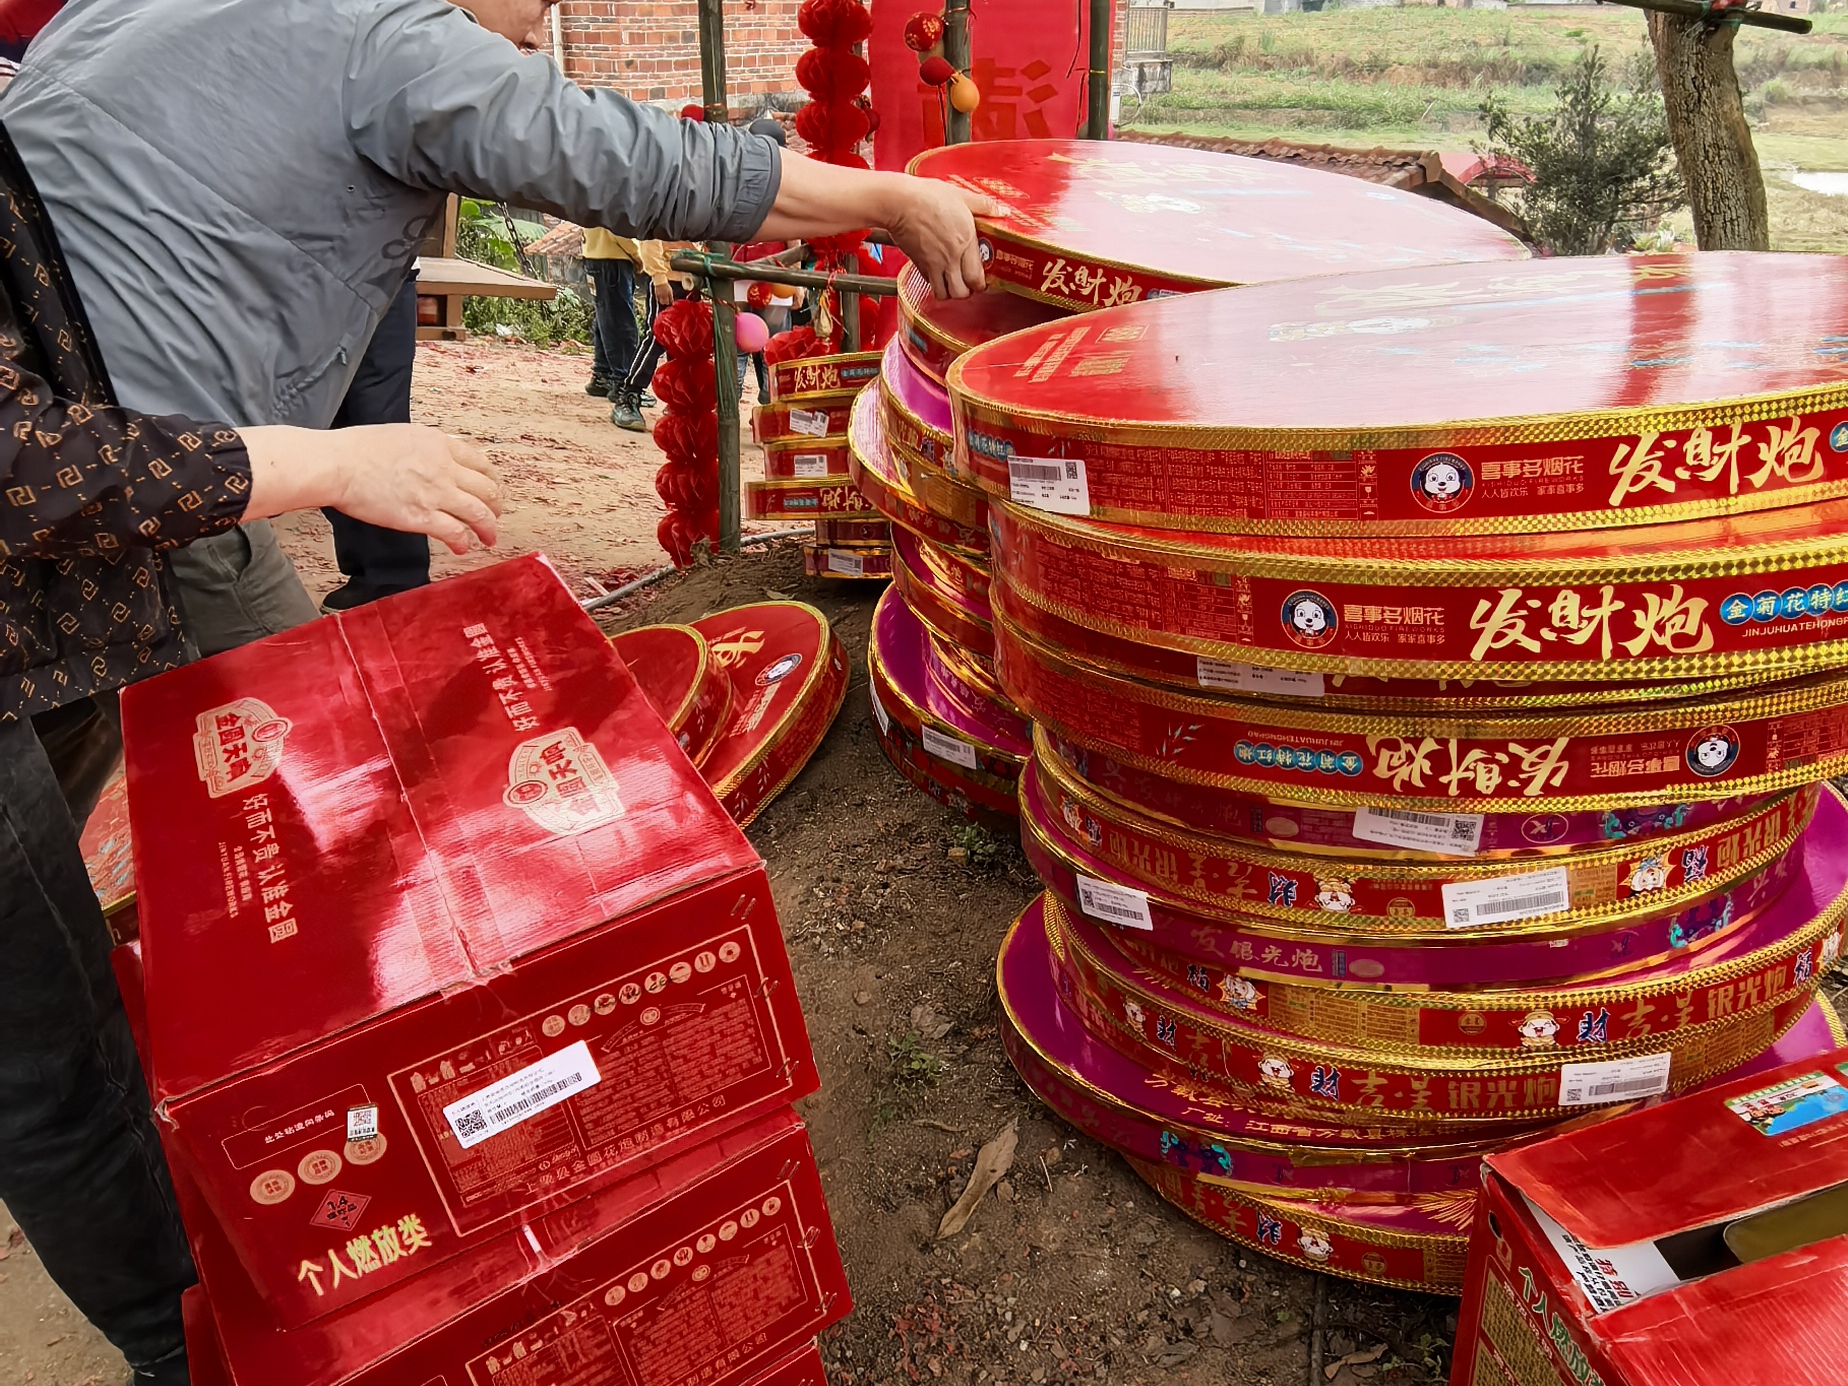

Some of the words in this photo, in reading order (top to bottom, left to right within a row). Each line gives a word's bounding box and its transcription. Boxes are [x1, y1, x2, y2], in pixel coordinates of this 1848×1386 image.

[1481, 456, 1585, 479] 喜事多烟花
[1344, 604, 1445, 625] 喜事多烟花
[297, 1215, 433, 1297] 个人燃放类
